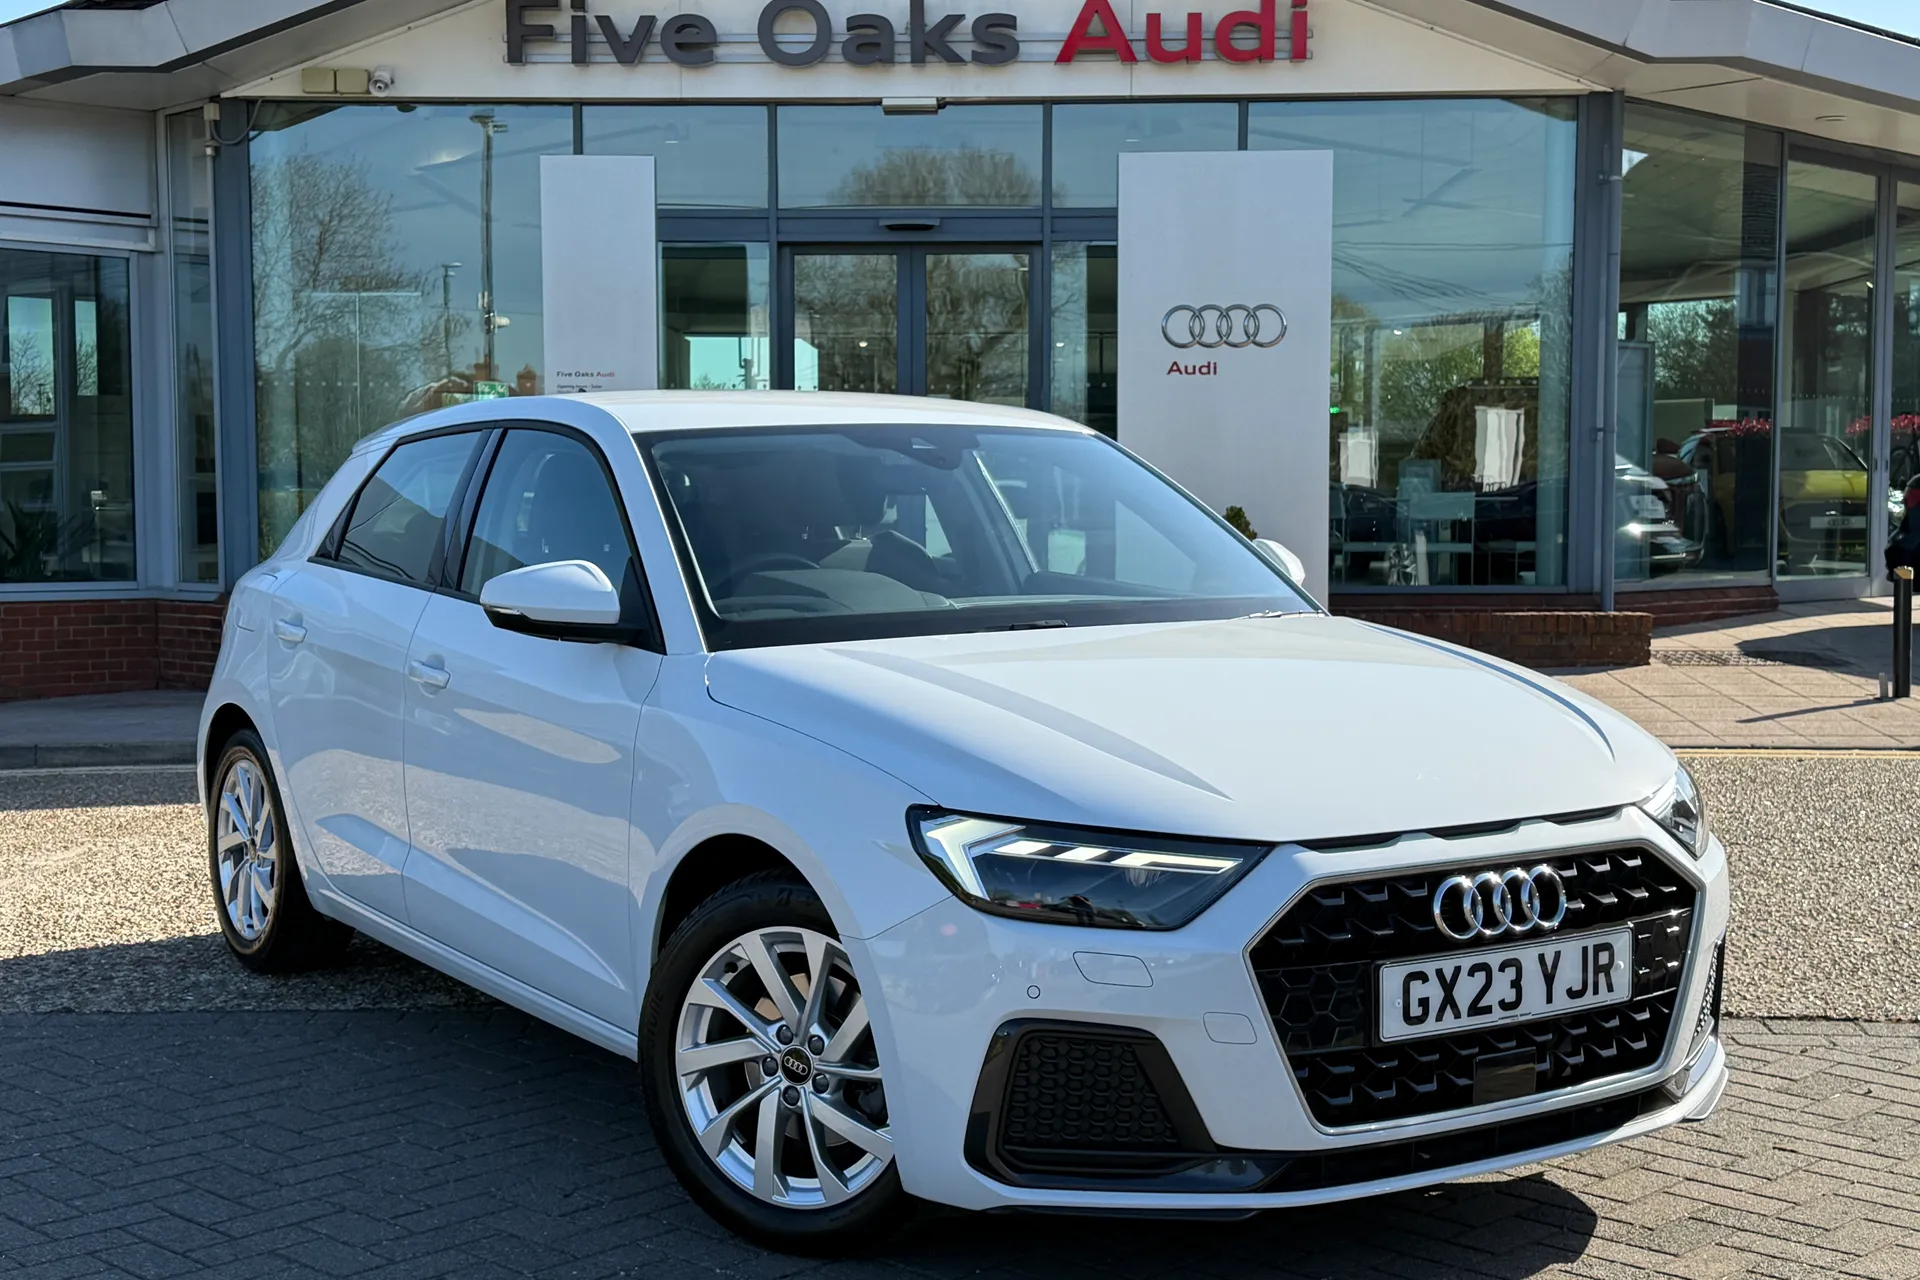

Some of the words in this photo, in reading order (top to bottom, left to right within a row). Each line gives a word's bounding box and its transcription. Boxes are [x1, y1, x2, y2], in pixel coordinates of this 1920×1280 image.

[506, 0, 717, 66] Five
[757, 0, 1020, 67] Oaks
[1054, 0, 1308, 65] Audi
[1166, 361, 1218, 376] Audi
[1402, 957, 1523, 1027] GX23
[1537, 941, 1615, 1005] YJR
